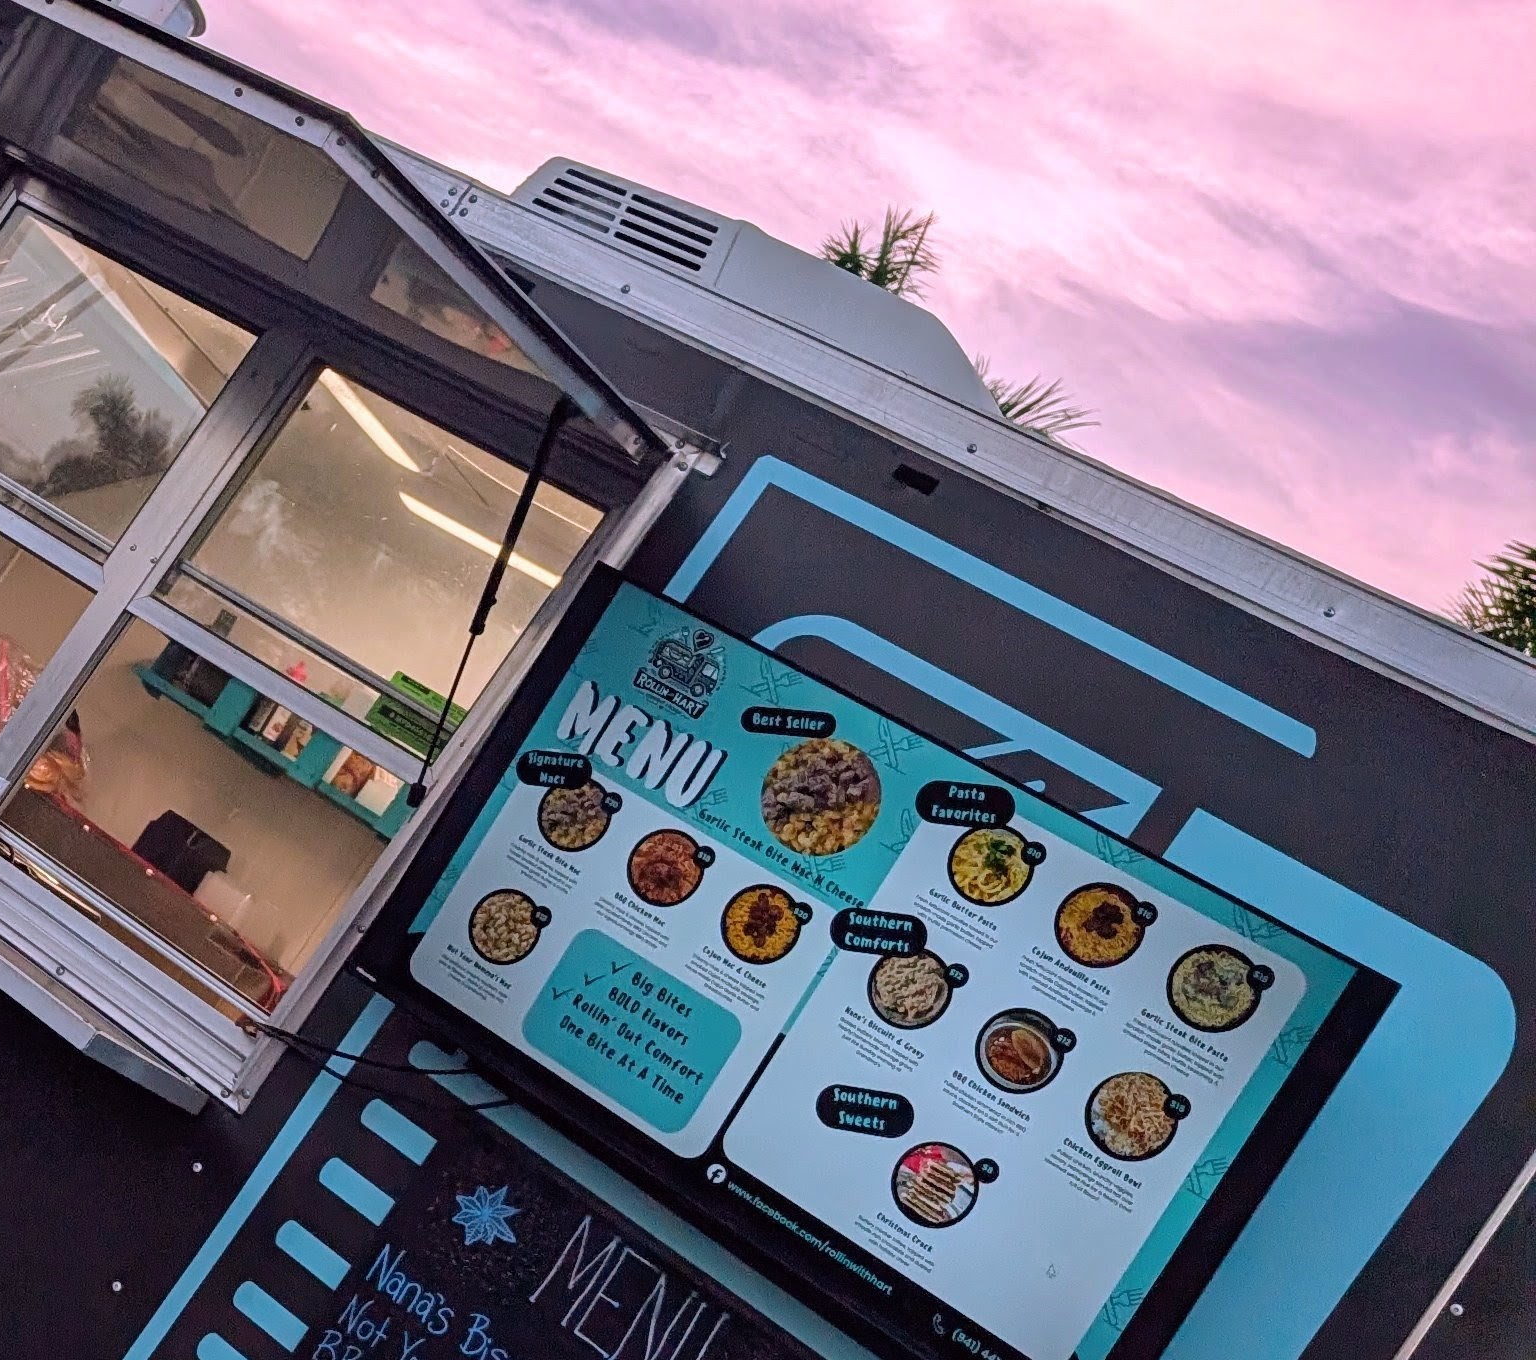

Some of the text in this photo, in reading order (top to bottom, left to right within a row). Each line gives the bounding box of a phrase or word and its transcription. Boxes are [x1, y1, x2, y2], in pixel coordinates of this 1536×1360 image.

[636, 672, 670, 701] ROLLIN
[669, 692, 704, 716] HART
[752, 712, 826, 731] Best Seller
[528, 751, 584, 769] Signature
[555, 679, 727, 813] MENU
[931, 804, 996, 824] Favorites
[948, 785, 986, 801] Pasta
[698, 808, 865, 912] Garlic Steak Bite Mac N Cheese
[614, 891, 666, 927] BBQ Chicken Mac
[849, 911, 913, 932] Southern
[928, 888, 998, 932] Garlic Butter Pasta
[844, 932, 910, 953] Comforts
[702, 945, 767, 989] Cajun Mac & Cheese
[1031, 945, 1111, 996] Cajun Andouille Pasta
[608, 986, 689, 1046] BOLD Flavors
[631, 971, 654, 997] Big
[656, 987, 693, 1018] Bites
[572, 993, 704, 1086] Rollin' Out Comfort
[844, 1006, 925, 1060] Nana's Biscuits & Gravy
[1140, 1008, 1229, 1063] Garlic Steak Bite Pasta
[559, 1014, 684, 1105] One Bite At A Time
[833, 1087, 898, 1110] Southern
[952, 1070, 1031, 1122] BBQ Chicken Sandwich
[838, 1110, 885, 1131] Sweets
[1063, 1137, 1143, 1190] Chicken Eggroll Bowl
[727, 1180, 893, 1296] www.facebook.com/rollinwithhart
[876, 1212, 933, 1253] Christmas Crack
[365, 1243, 455, 1335] Nana's
[337, 1293, 391, 1348] Not
[951, 1328, 981, 1354] (941)
